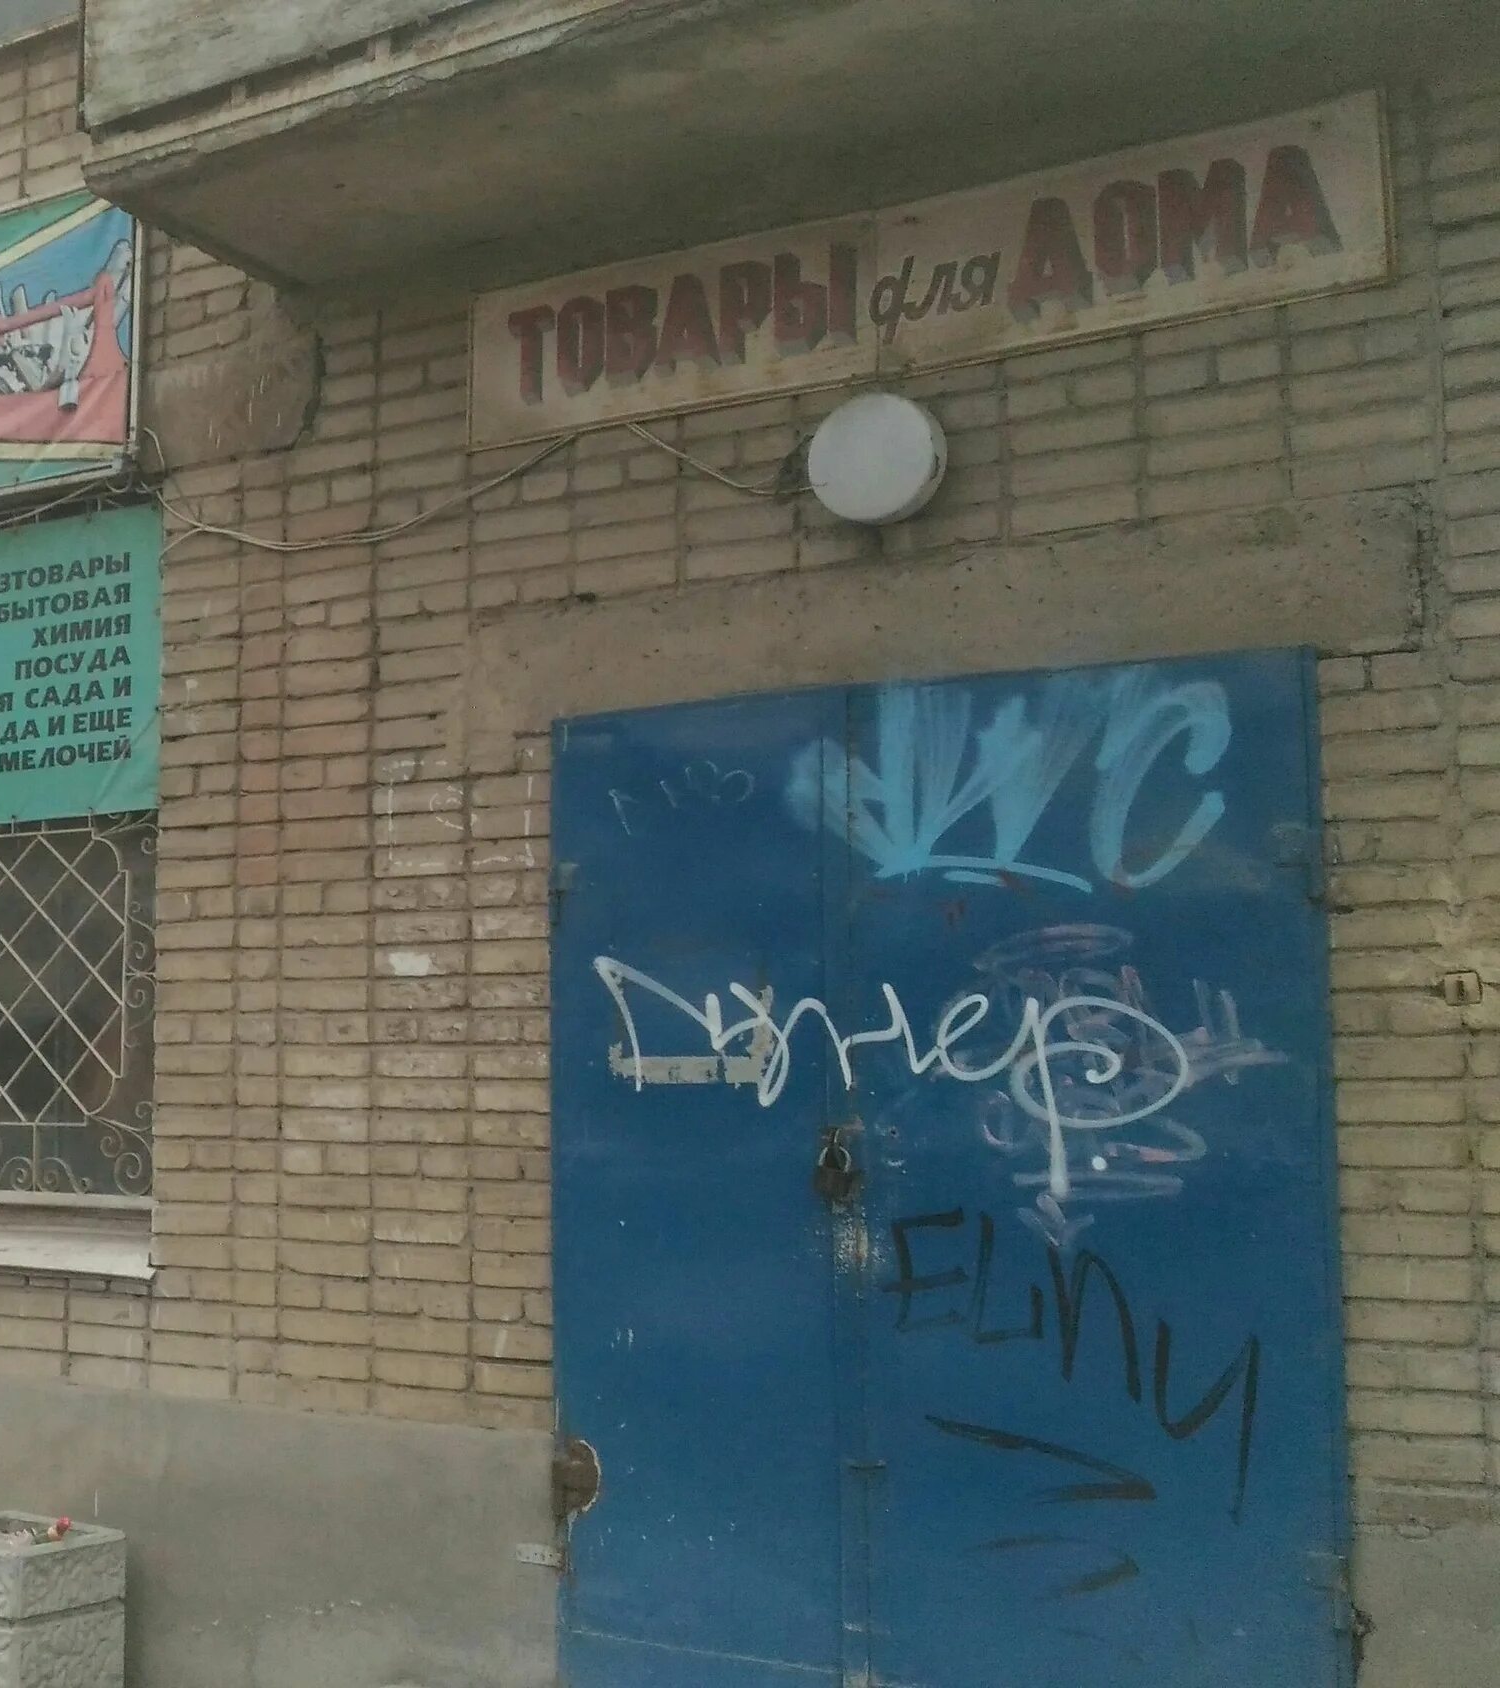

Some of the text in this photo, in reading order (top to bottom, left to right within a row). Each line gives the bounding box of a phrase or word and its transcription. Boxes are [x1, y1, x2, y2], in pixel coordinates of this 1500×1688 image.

[507, 145, 1344, 405] ТОВАРЫ для ДОМА
[31, 614, 132, 649] ХИМИЯ
[14, 645, 132, 681] ПОСУДА
[25, 680, 105, 709] САДА
[112, 676, 132, 698] И
[47, 716, 66, 738] И
[72, 707, 132, 734] ЕЩЕ
[0, 734, 132, 773] МЕЛОЧЕЙ
